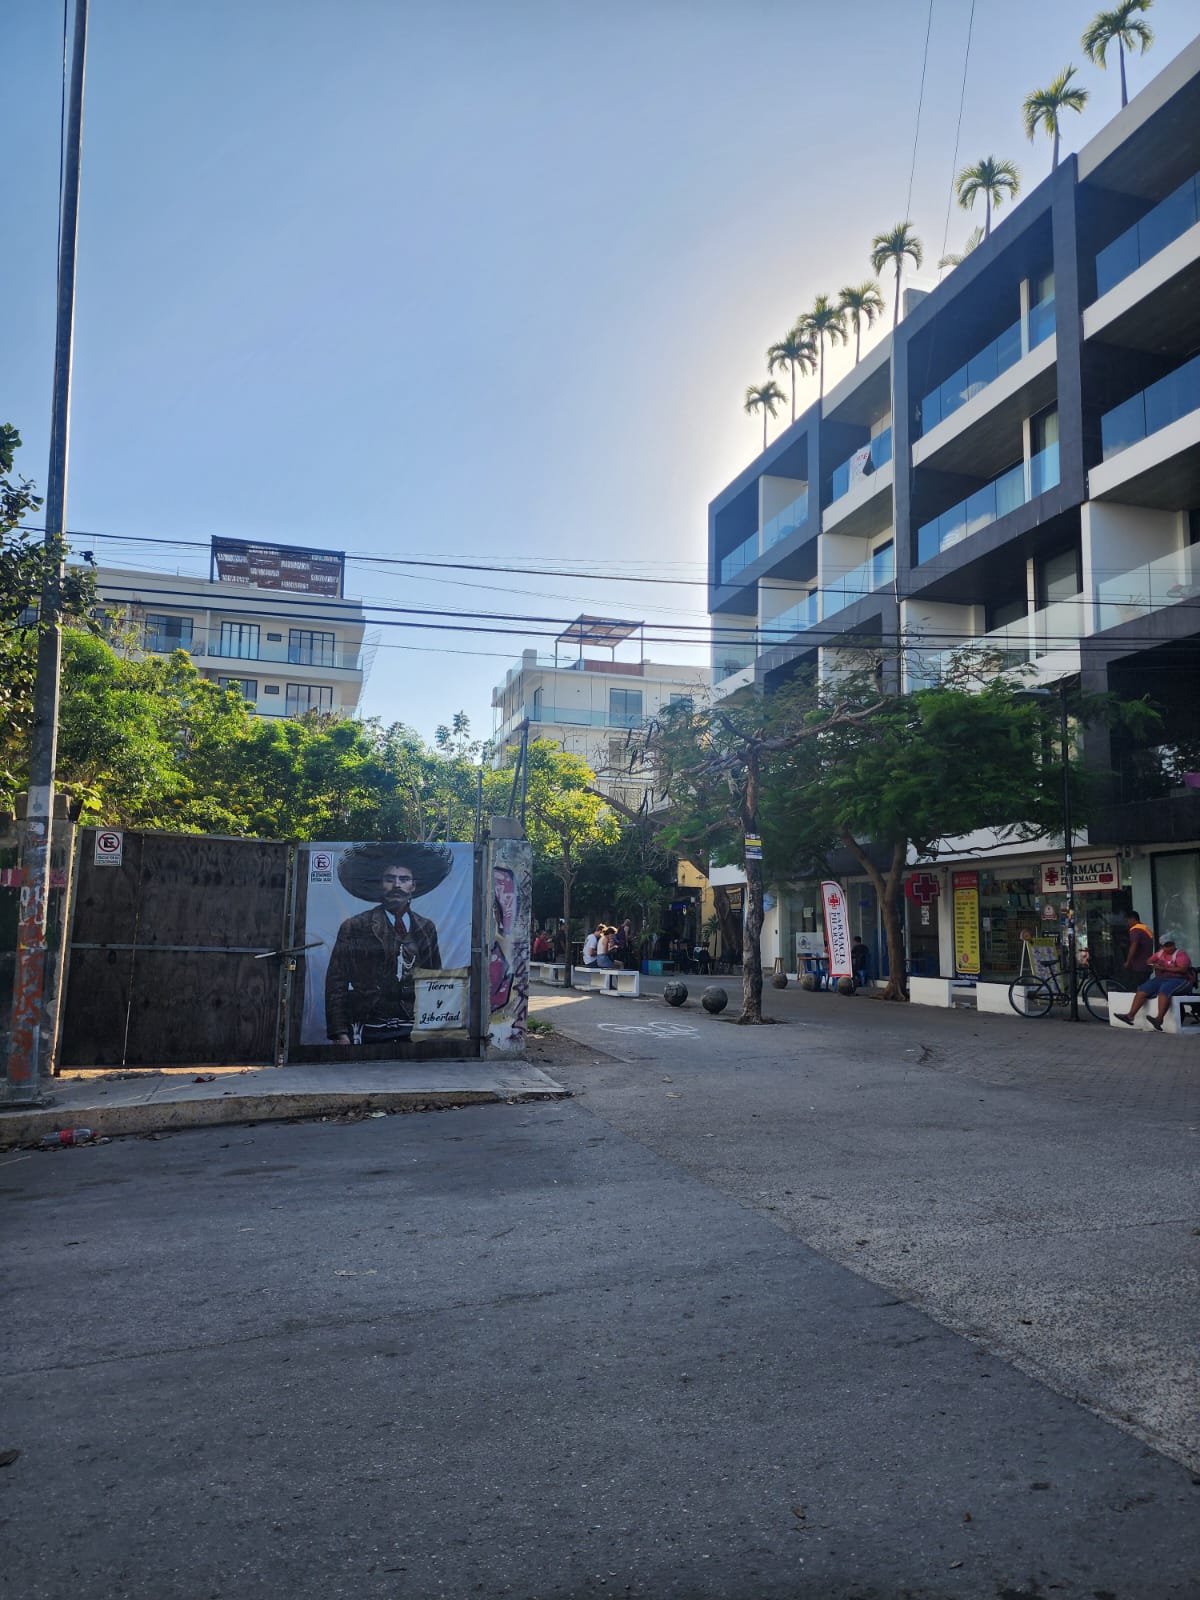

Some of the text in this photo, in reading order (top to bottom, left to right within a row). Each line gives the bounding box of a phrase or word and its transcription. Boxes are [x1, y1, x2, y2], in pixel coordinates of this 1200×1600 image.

[1060, 862, 1112, 875] FRMACIA
[1060, 874, 1098, 882] PRMACY
[836, 912, 846, 965] FARMACIA
[426, 981, 454, 991] Tierra
[436, 999, 443, 1009] y
[419, 1010, 461, 1025] Libertad
